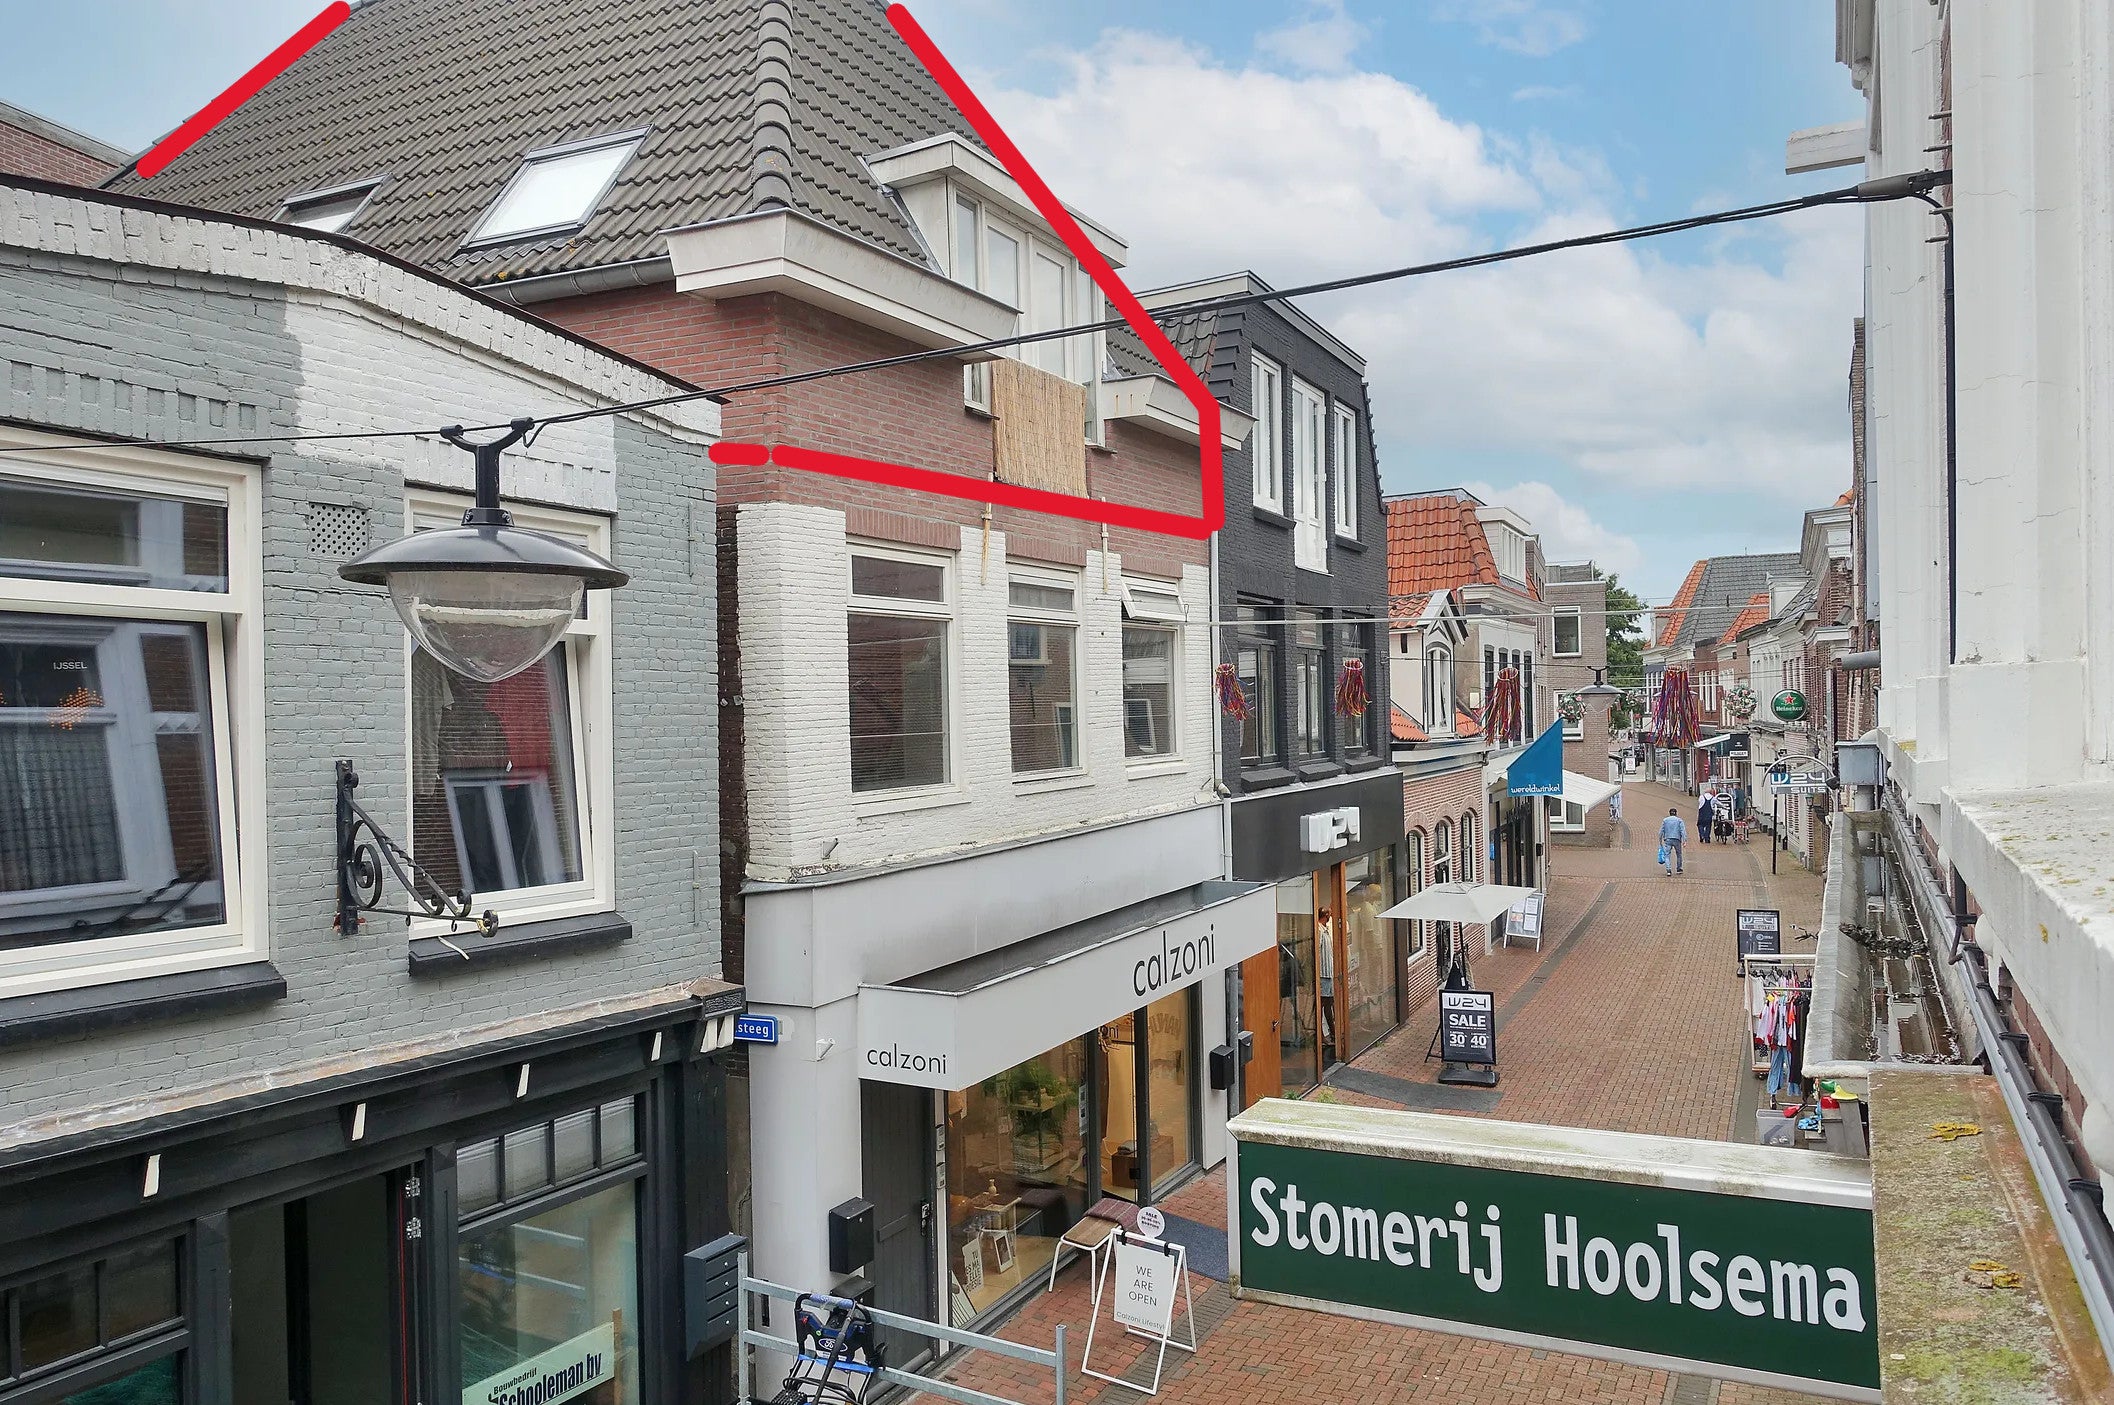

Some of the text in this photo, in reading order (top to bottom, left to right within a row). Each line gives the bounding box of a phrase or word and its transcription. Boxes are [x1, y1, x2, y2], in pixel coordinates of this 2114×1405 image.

[53, 662, 88, 670] IJSSEL
[1771, 772, 1826, 785] W24
[1510, 783, 1561, 794] wereldwinkel
[1790, 786, 1827, 794] SUITS
[1133, 923, 1216, 997] calzoni
[1448, 996, 1487, 1009] W24
[1449, 1013, 1486, 1027] SALE
[737, 1022, 769, 1038] steeg
[867, 1042, 948, 1075] calzoni
[1250, 1176, 1867, 1333] Stomerij Hoolsema
[1136, 1265, 1152, 1277] WE
[1133, 1279, 1154, 1292] ARE
[1128, 1291, 1158, 1306] OPEN
[1142, 1318, 1165, 1330] Lifestyl
[586, 1352, 602, 1380] bv
[493, 1367, 537, 1395] Bouwbedrijf
